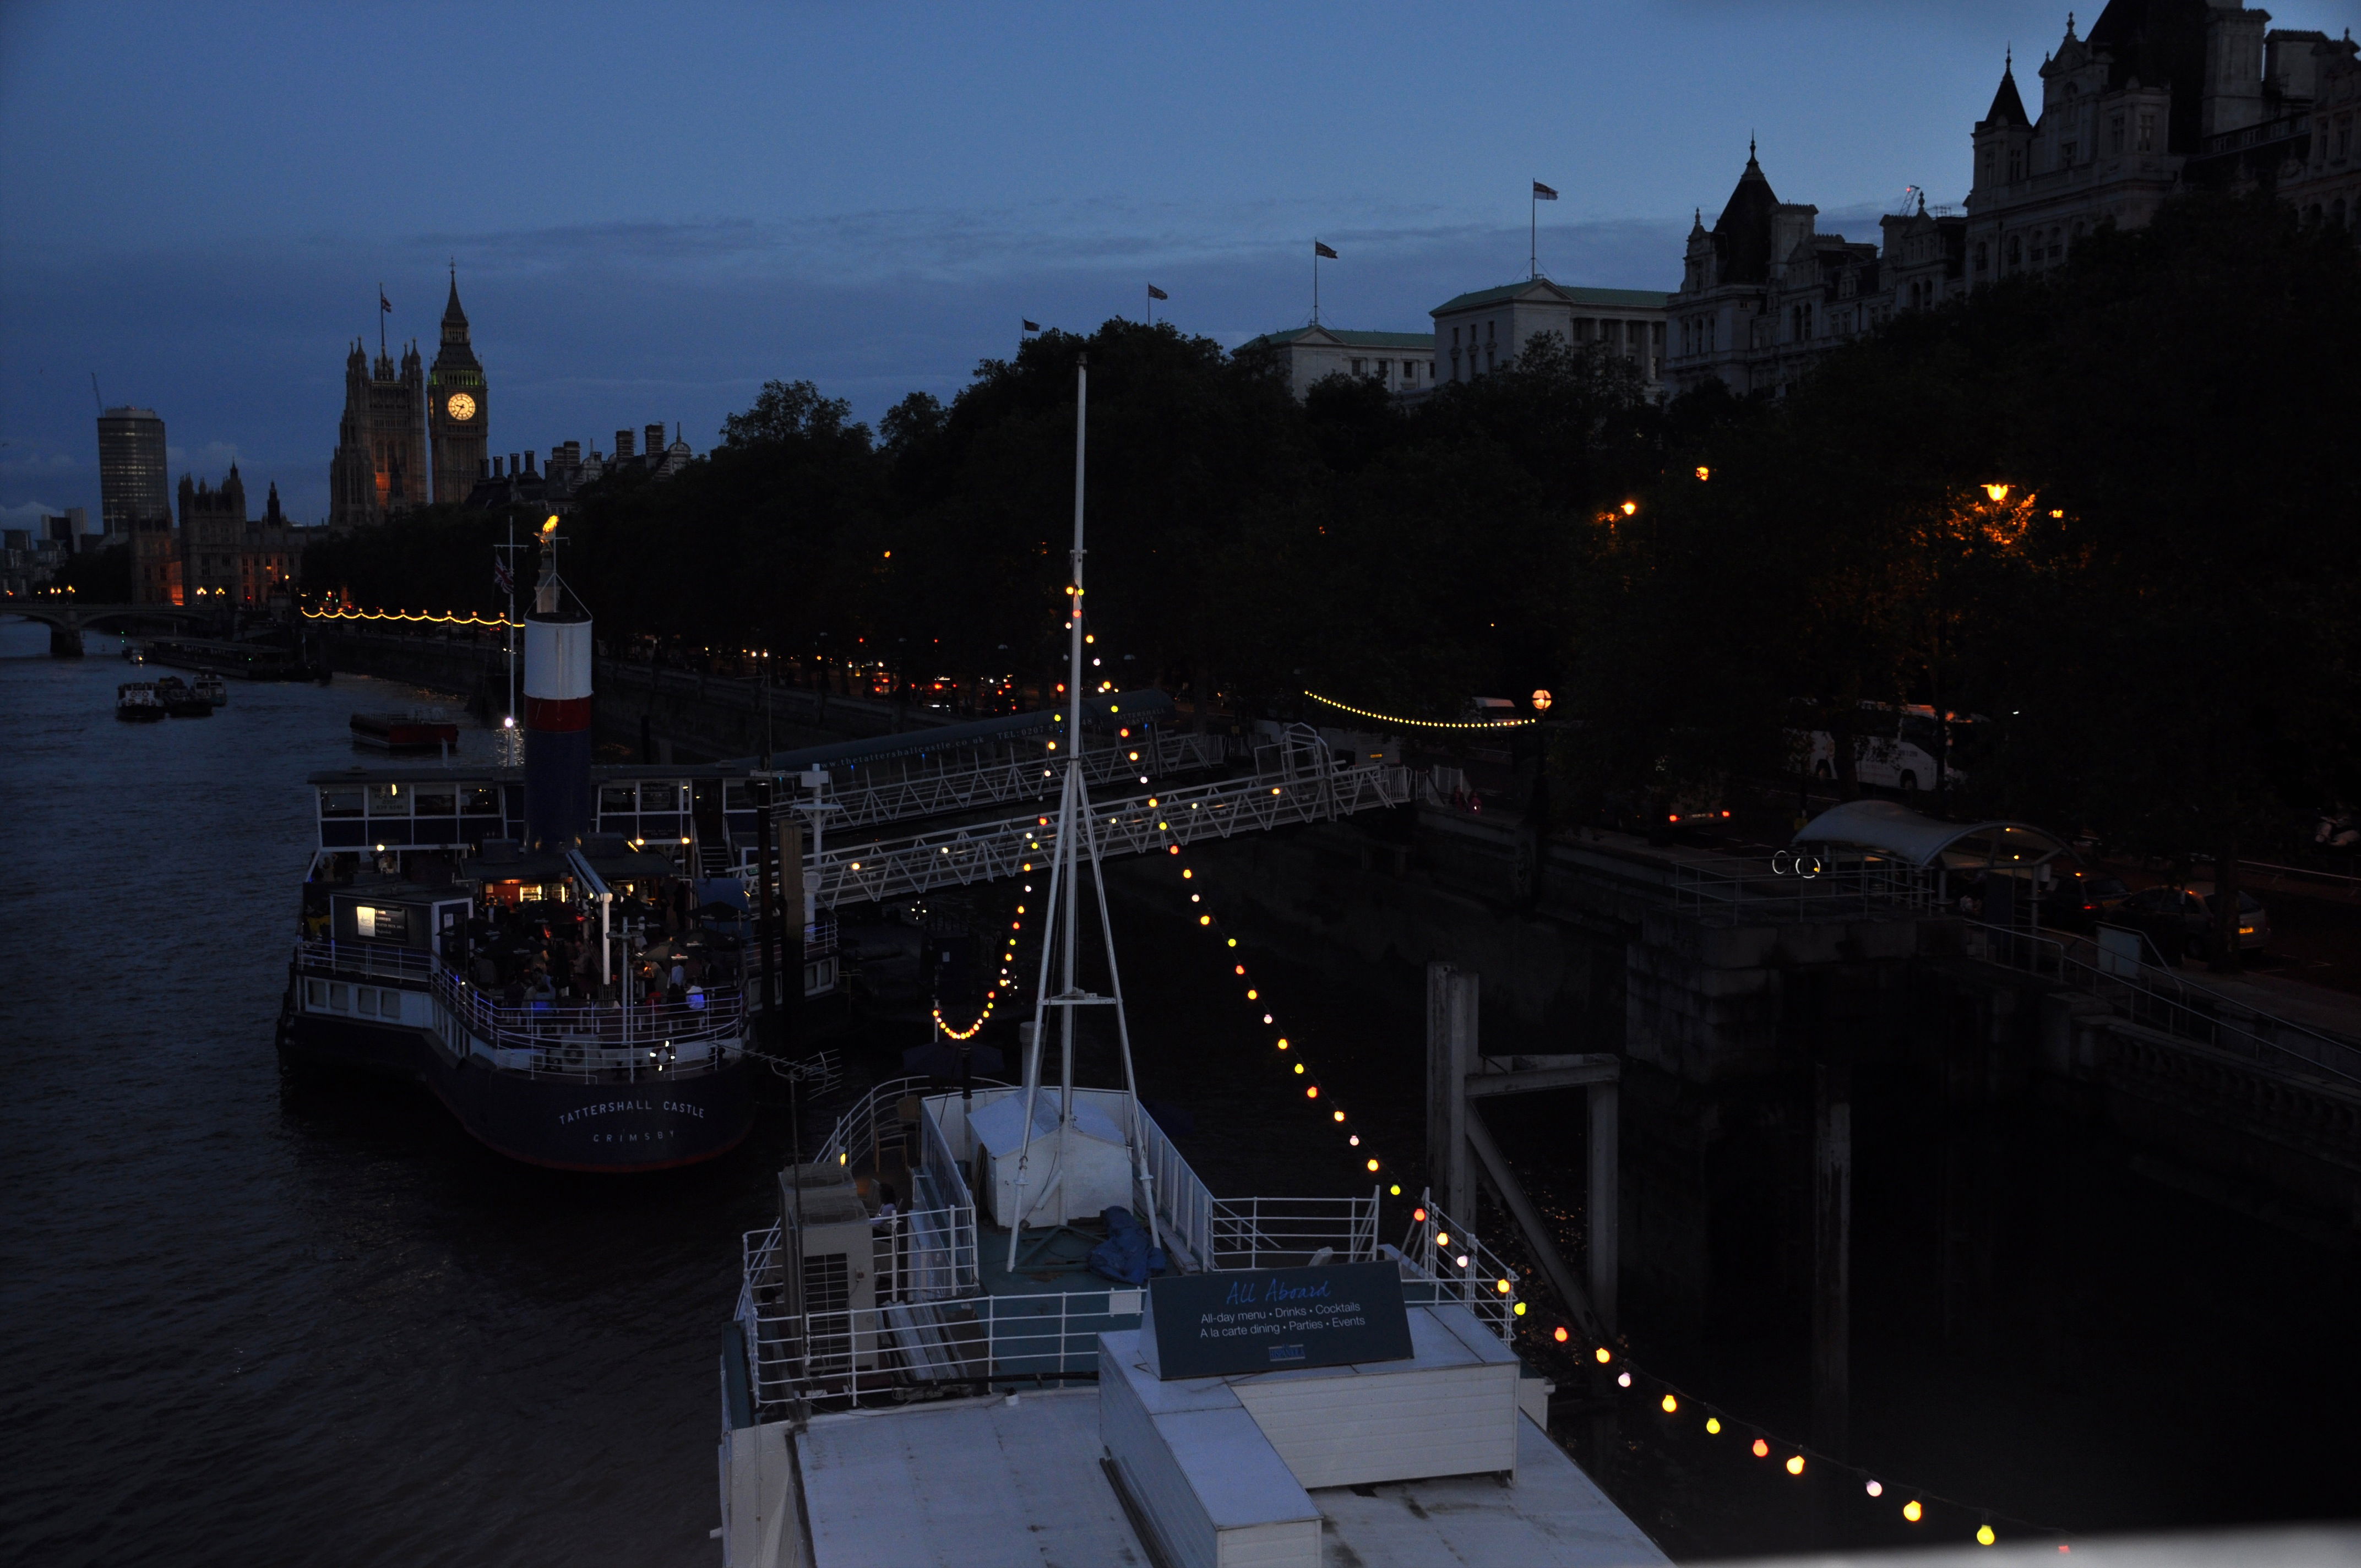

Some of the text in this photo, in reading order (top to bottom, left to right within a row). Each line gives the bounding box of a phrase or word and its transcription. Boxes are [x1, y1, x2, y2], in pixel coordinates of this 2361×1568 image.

[1021, 726, 1044, 736] 0207
[559, 1100, 705, 1125] TATTERSHALL CASTLE
[593, 1130, 674, 1142] GRIMSBY
[1226, 1278, 1331, 1305] All Aboard
[1201, 1302, 1361, 1324] All-day menu Drinks Cocktails
[1200, 1316, 1366, 1338] A la carte dining Parties Events
